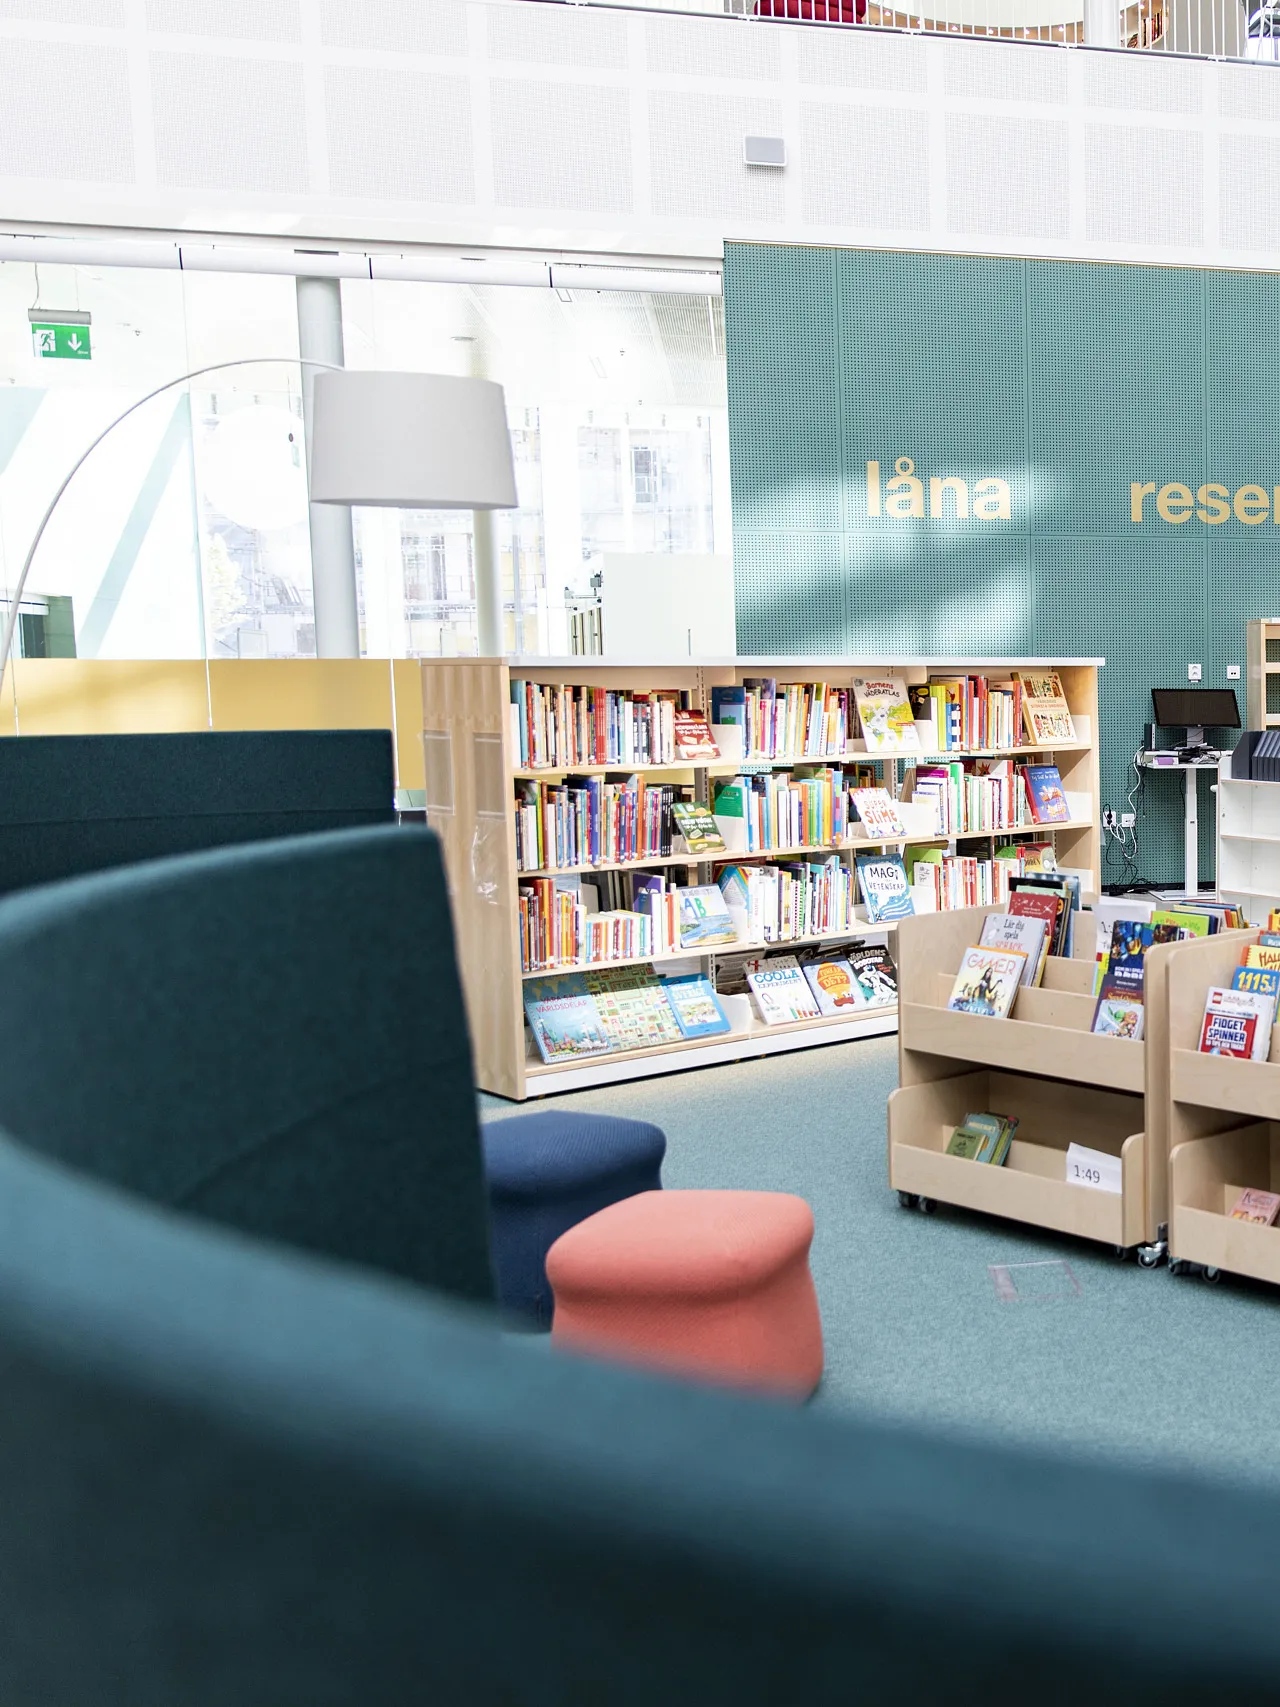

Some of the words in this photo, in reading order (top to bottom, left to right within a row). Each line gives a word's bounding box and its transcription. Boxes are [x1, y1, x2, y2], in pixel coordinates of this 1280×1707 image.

[867, 457, 1011, 520] låna
[866, 682, 894, 690] Barnens
[848, 949, 886, 964] VÄRLDENS
[967, 953, 1017, 975] GAMER
[754, 969, 800, 983] COOLA
[1238, 971, 1271, 992] 1115
[1213, 1017, 1245, 1030] FIDGET
[1208, 1028, 1246, 1042] SPINNER
[1074, 1165, 1101, 1184] 1:49
